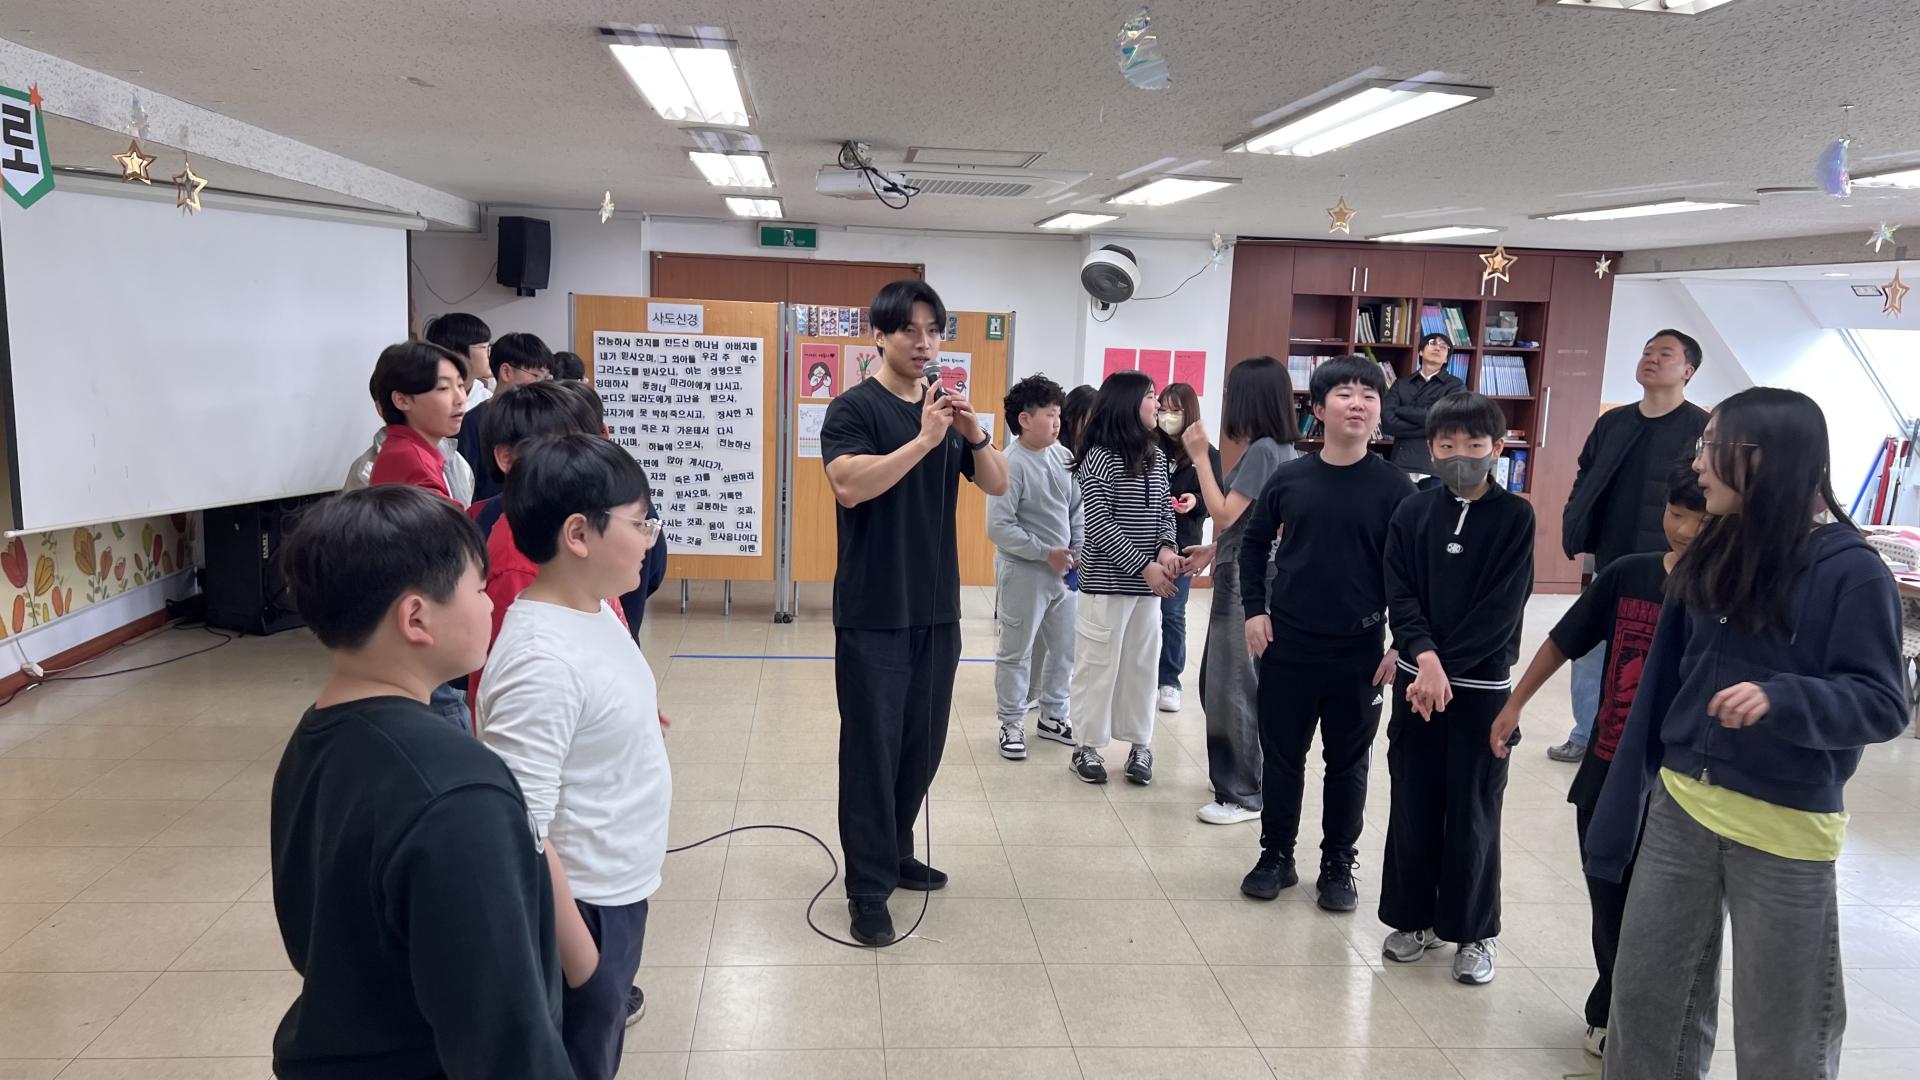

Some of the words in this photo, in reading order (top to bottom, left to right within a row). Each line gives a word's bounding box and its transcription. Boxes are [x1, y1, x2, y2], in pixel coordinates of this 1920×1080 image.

[2, 103, 39, 174] 로
[652, 312, 698, 326] 사도신경
[598, 337, 630, 347] 전능하사
[695, 341, 718, 349] 하나님
[725, 342, 757, 350] 아버지를
[600, 352, 616, 360] 내가
[659, 355, 667, 363] 그
[702, 352, 717, 361] 우리
[741, 355, 756, 363] 예수
[598, 365, 638, 376] 그리스도를
[686, 367, 701, 375] 이는
[711, 366, 741, 375] 성령으로
[596, 379, 628, 388] 잉태하사
[671, 378, 711, 390] 마리아에게
[676, 395, 699, 403] 고난을
[640, 409, 647, 417] 못
[746, 408, 753, 416] 지
[608, 426, 615, 435] 흘
[620, 426, 635, 434] 만에
[662, 425, 669, 433] 자
[717, 426, 733, 435] 다시
[720, 439, 750, 449] 전능하신
[695, 473, 710, 481] 자를
[723, 472, 754, 483] 심판하러
[670, 504, 685, 512] 서로
[696, 502, 727, 511] 교통하는
[737, 521, 751, 529] 다시
